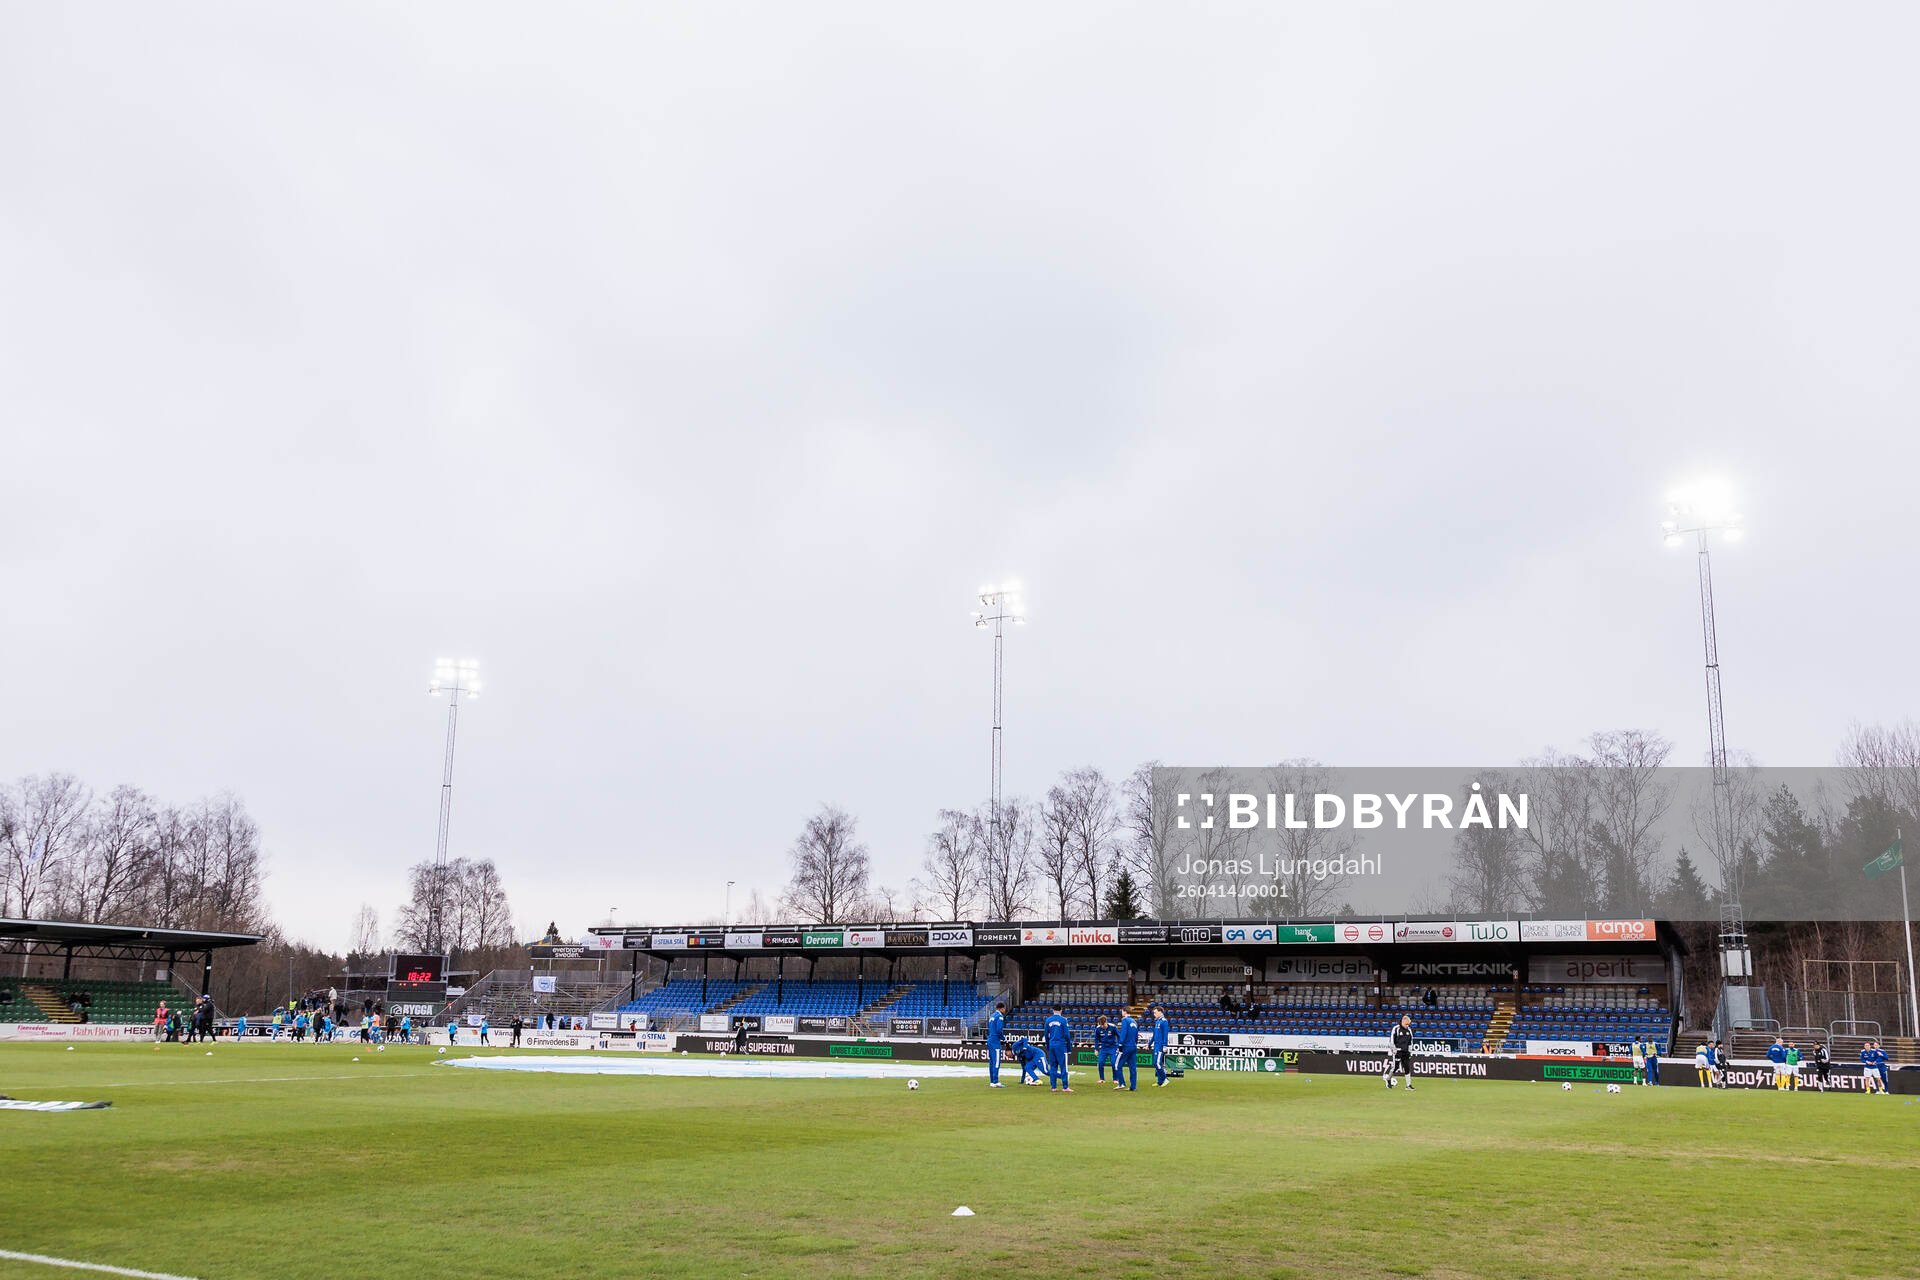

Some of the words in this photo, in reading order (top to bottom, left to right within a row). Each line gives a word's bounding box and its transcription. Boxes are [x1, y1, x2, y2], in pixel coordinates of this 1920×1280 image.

[1466, 923, 1508, 940] TuJo
[1595, 921, 1645, 934] ramo
[806, 936, 838, 945] Derome
[932, 932, 968, 940] DOXA
[1071, 930, 1115, 943] nivika.
[1226, 929, 1245, 941] GA
[1253, 929, 1273, 941] GA
[552, 947, 585, 955] everbrand
[1045, 963, 1065, 974] 3M
[1401, 963, 1513, 974] ZINKTEKNIK
[1566, 959, 1637, 982] aperit
[408, 972, 432, 981] 18:22
[533, 1037, 569, 1046] Finnvedens
[570, 1038, 579, 1046] Bil
[706, 1041, 713, 1051] VI
[748, 1043, 795, 1053] SUPERETTAN
[931, 1048, 940, 1058] VI
[1167, 1048, 1209, 1056] TECHNO
[1220, 1048, 1266, 1057] TECHNO
[1609, 1045, 1629, 1053] BEMA
[1193, 1056, 1258, 1072] SUPERETTAN
[1346, 1060, 1357, 1072] VI
[1413, 1062, 1487, 1076] SUPERETTAN
